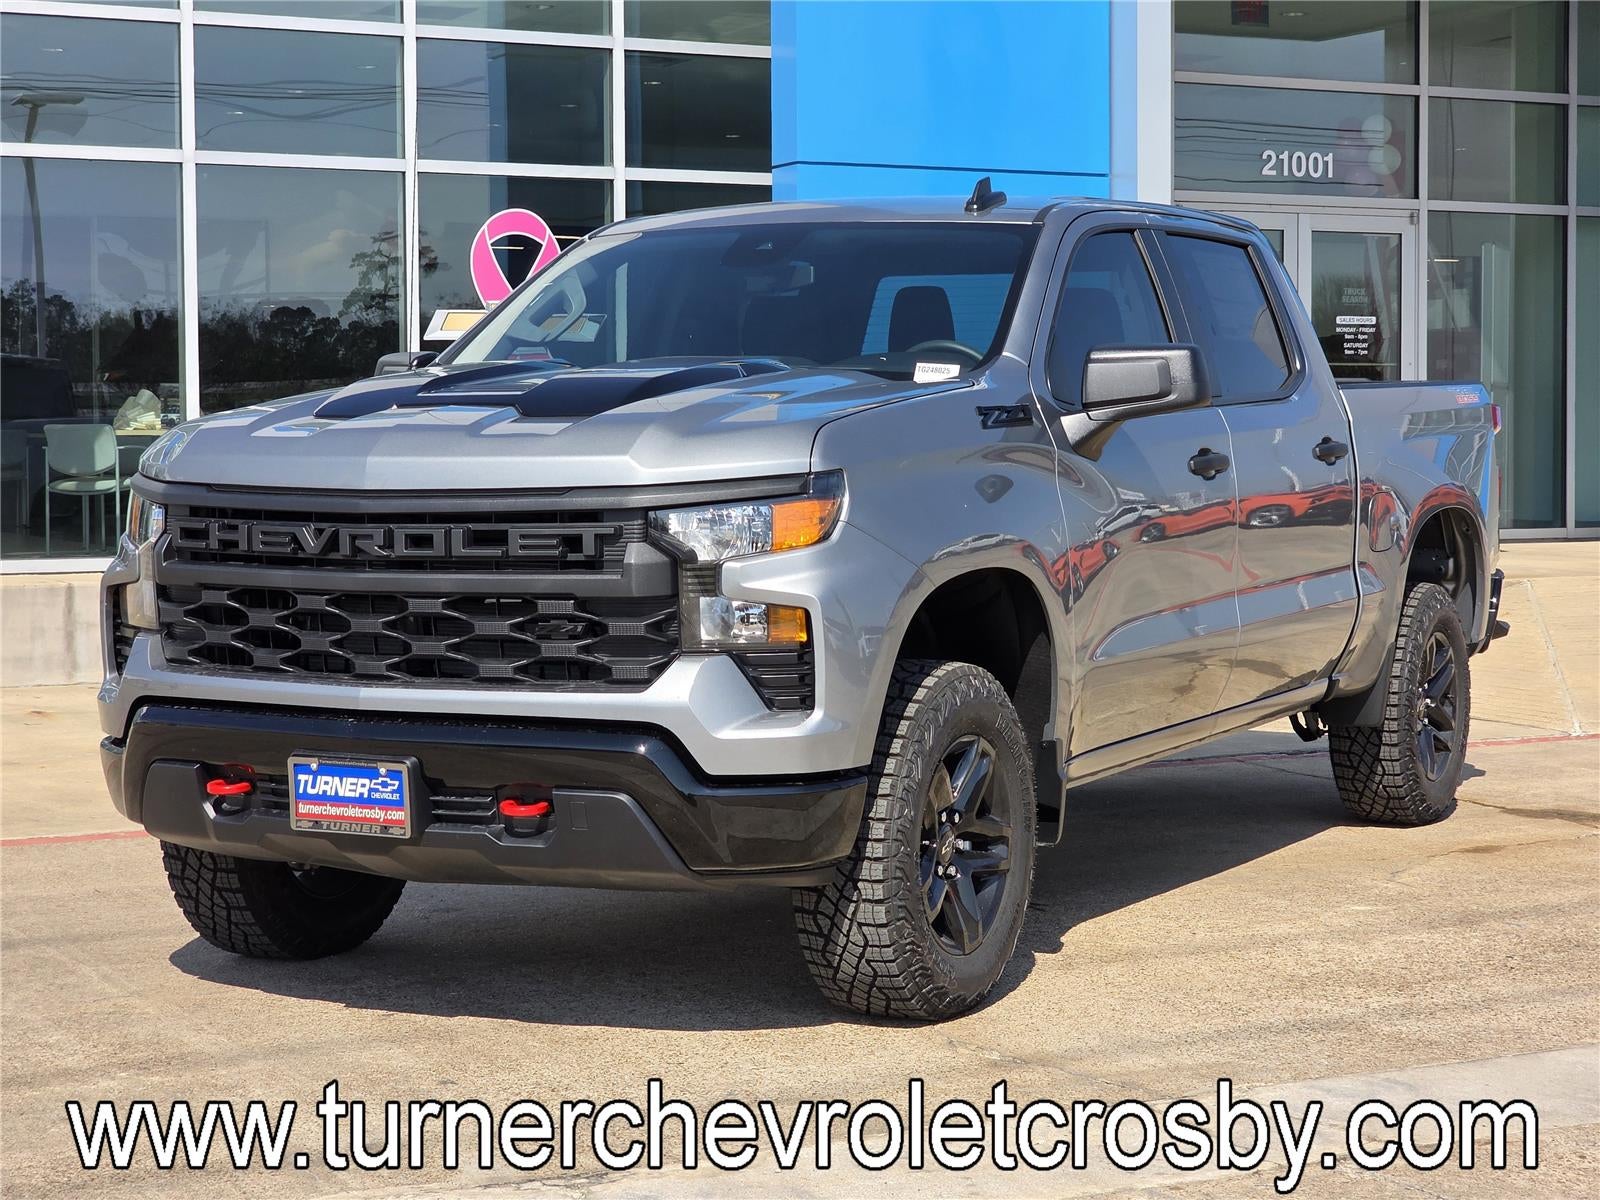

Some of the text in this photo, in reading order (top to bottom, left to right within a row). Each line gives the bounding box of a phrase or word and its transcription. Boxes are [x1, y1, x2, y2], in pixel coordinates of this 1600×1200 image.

[1261, 150, 1334, 178] 21001
[172, 519, 625, 559] CHEVROLET
[297, 774, 371, 798] TURNER
[371, 791, 400, 800] CHEVROLET
[298, 801, 405, 821] turnerchevroletcrosby.com
[321, 821, 381, 834] TURNER
